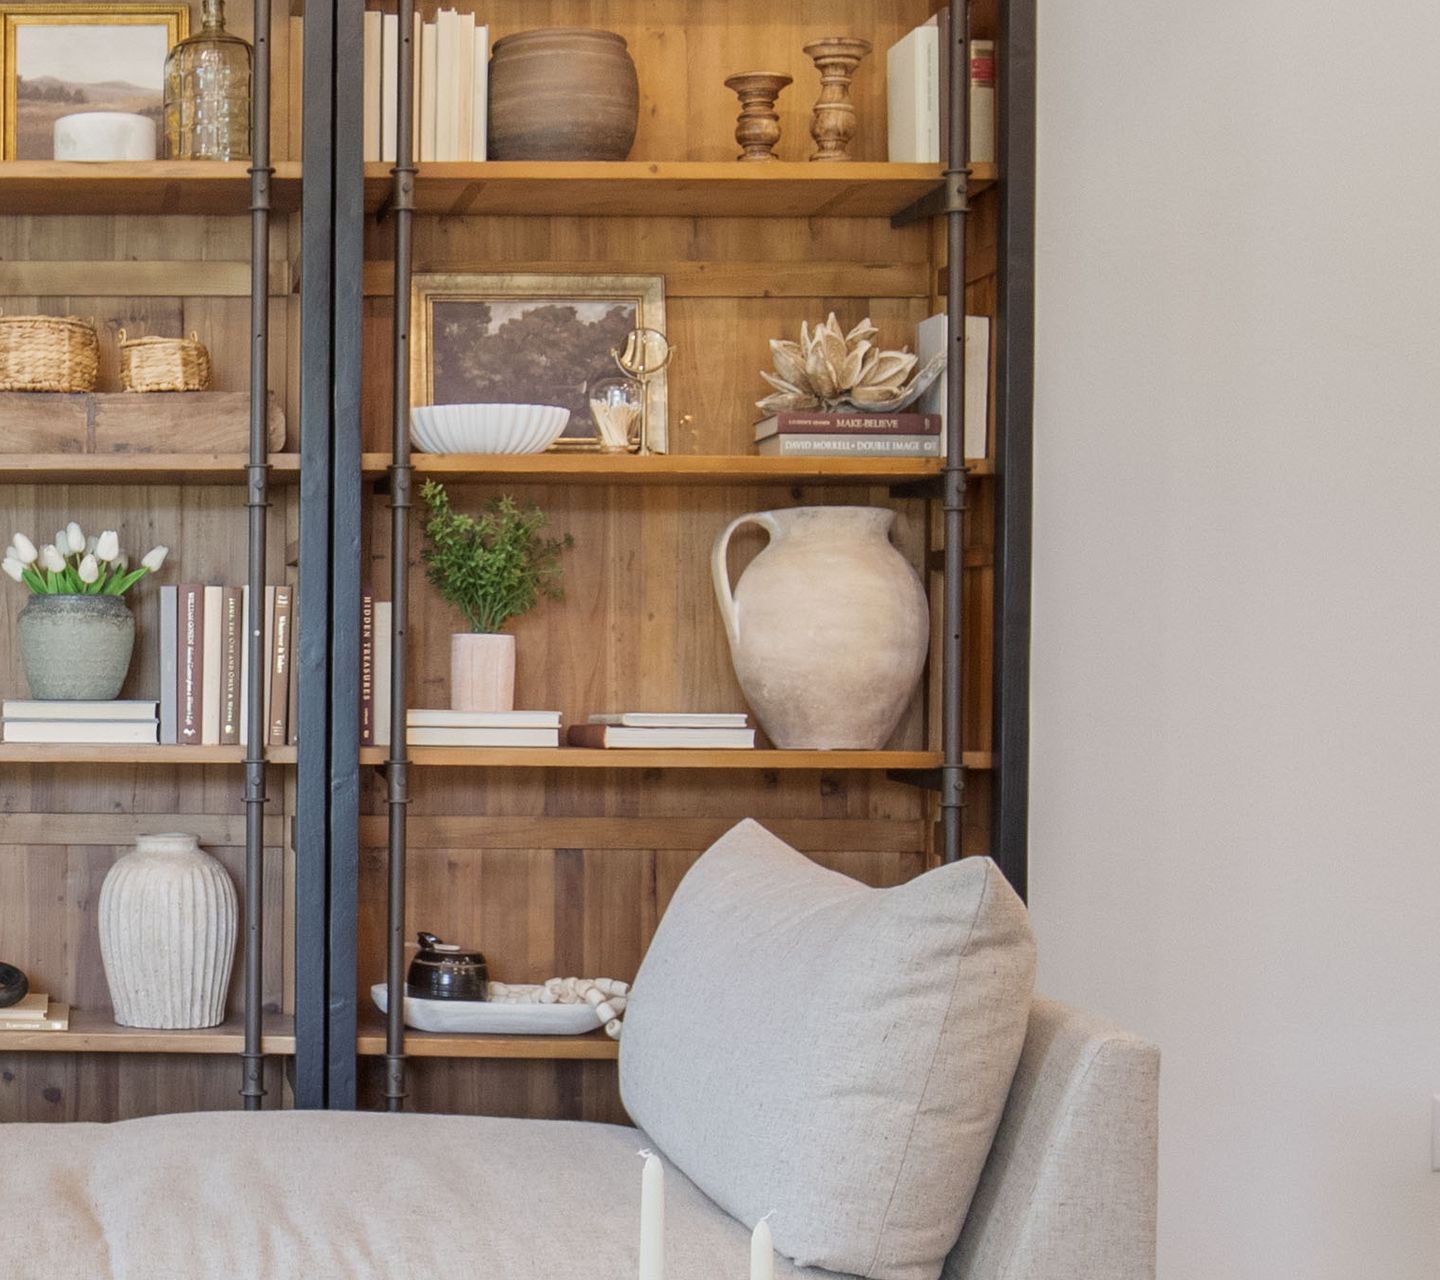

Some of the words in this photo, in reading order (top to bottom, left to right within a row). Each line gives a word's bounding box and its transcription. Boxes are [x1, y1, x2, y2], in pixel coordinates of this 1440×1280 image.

[836, 419, 898, 429] MAKE-BELIEVE
[784, 440, 812, 450] DAVID
[856, 440, 891, 451] DOUBLE
[892, 441, 919, 451] IMAGE
[187, 592, 195, 620] WILLIAM
[363, 596, 371, 638] HIDDEN
[363, 642, 371, 701] TREASURES
